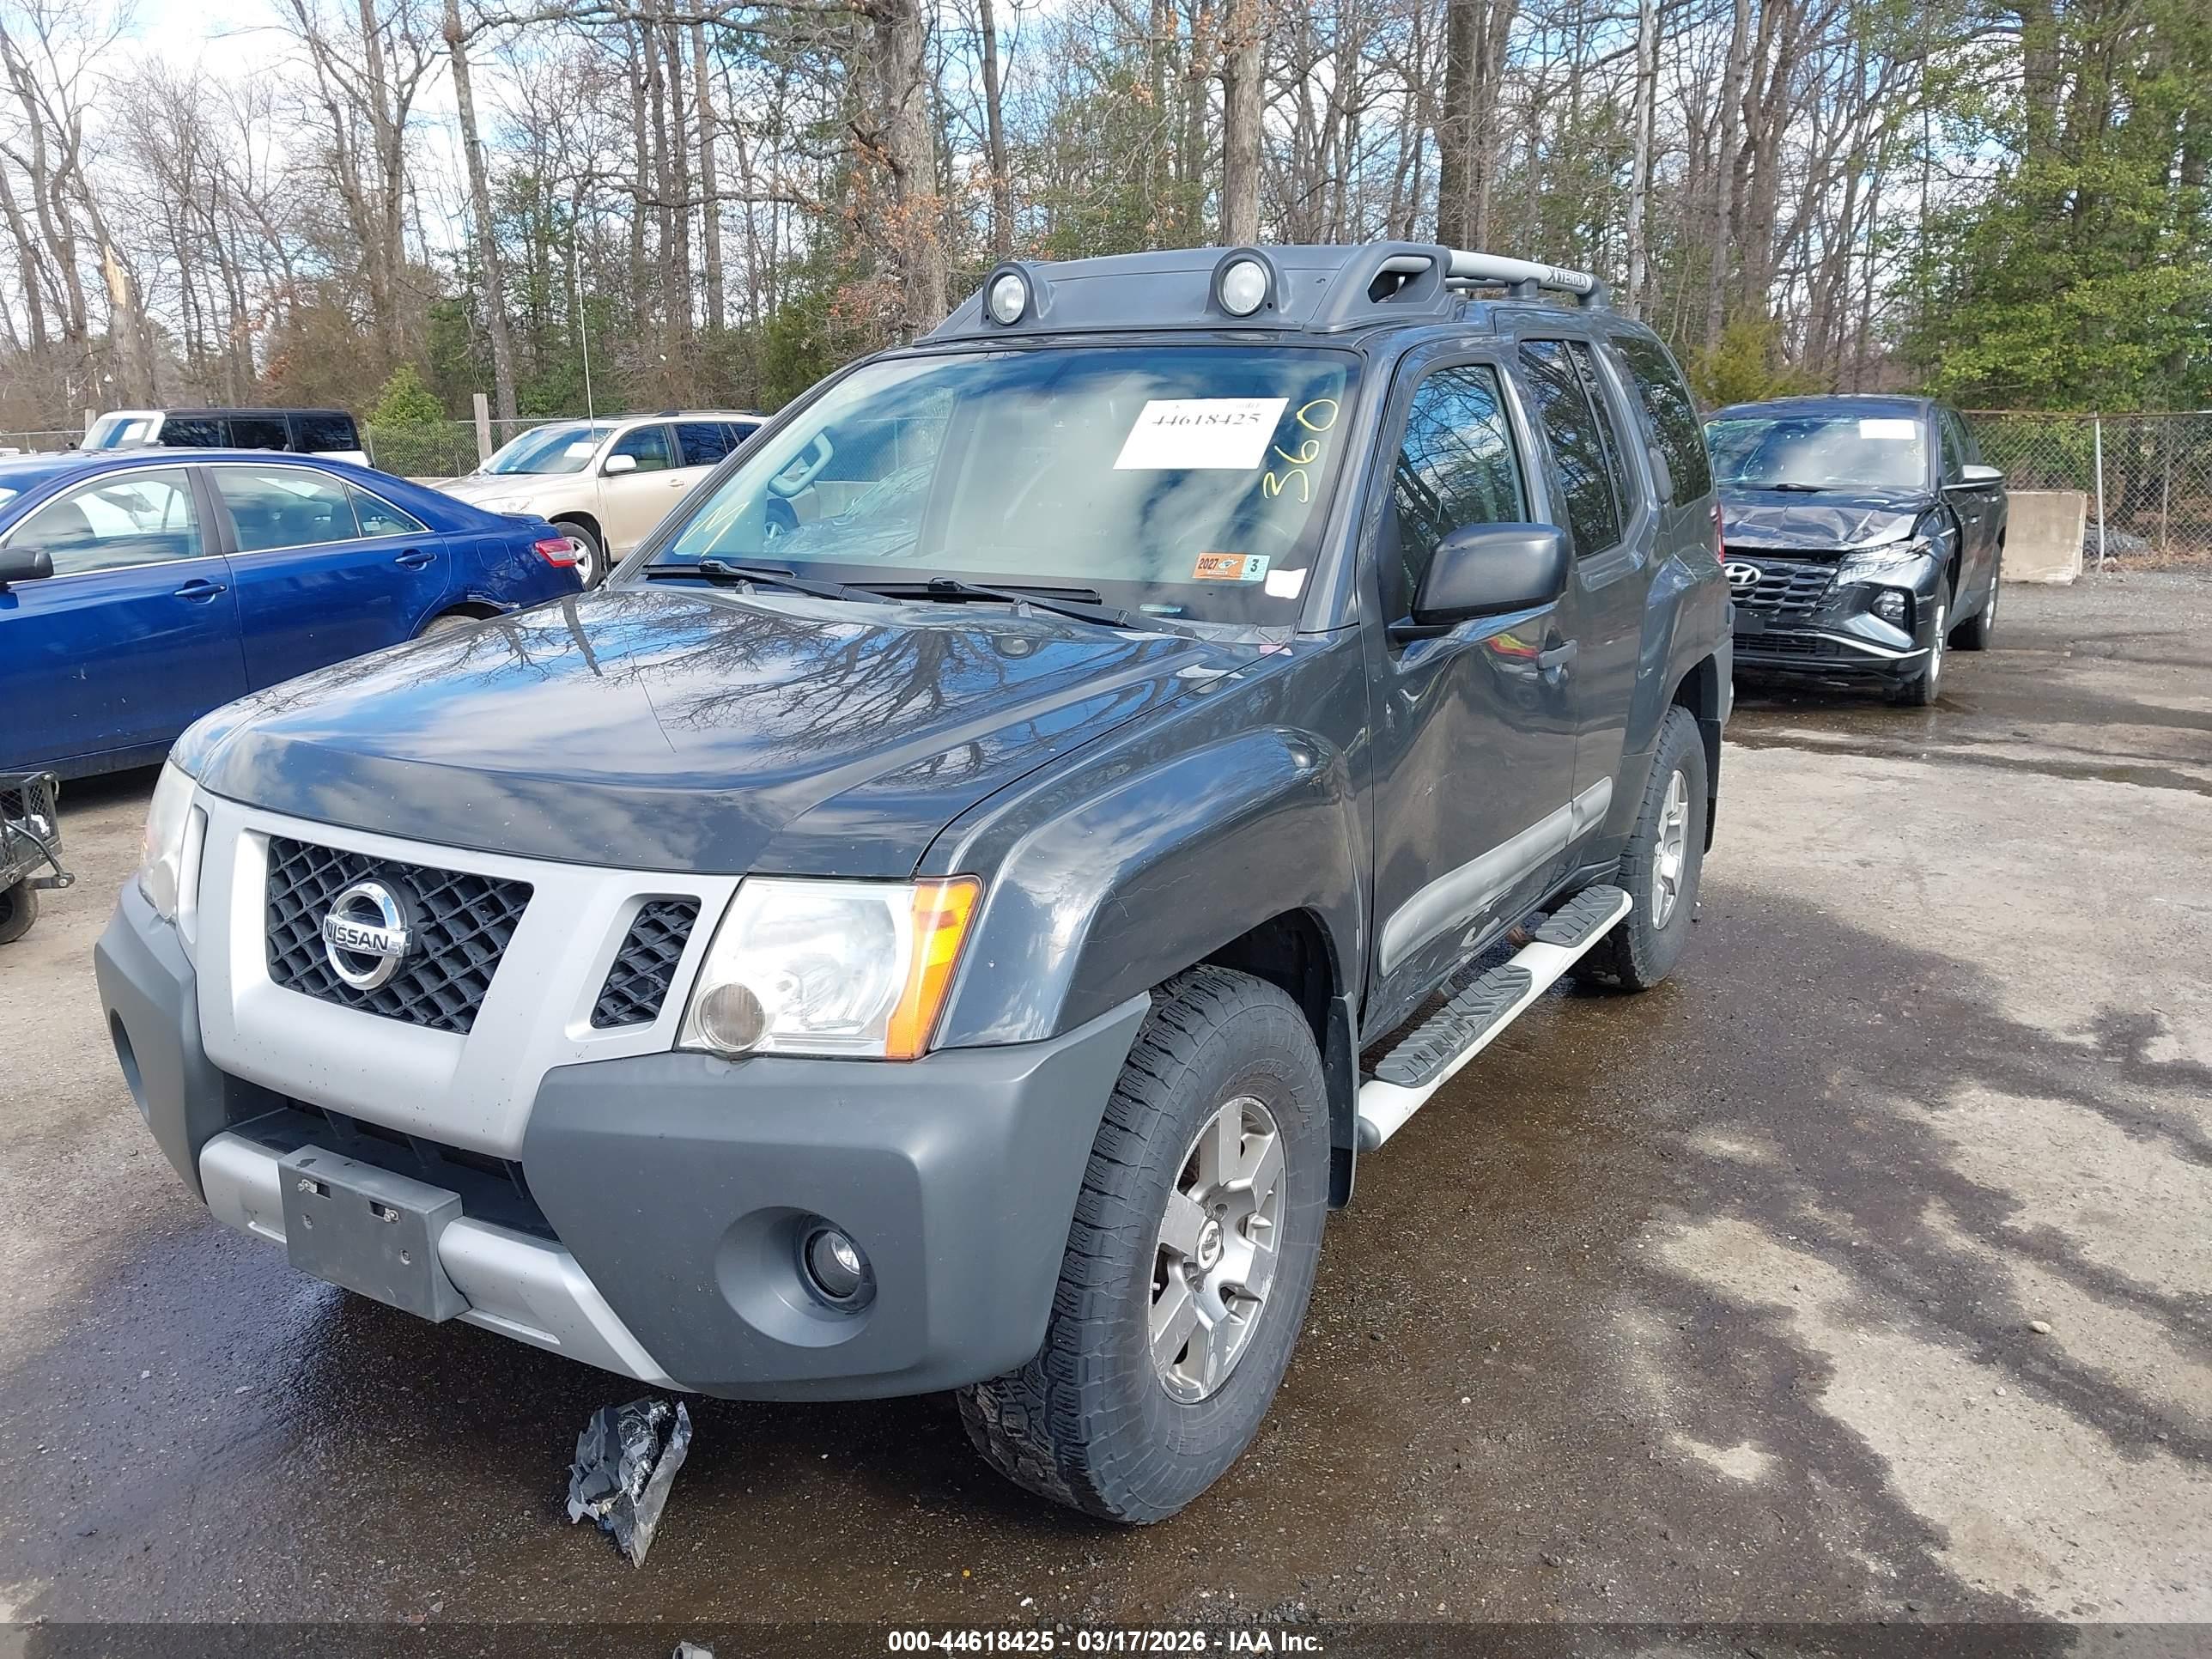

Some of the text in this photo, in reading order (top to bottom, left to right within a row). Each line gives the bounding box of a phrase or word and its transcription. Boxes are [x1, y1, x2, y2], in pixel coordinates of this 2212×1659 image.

[1546, 266, 1588, 289] XTERRA
[1152, 413, 1261, 426] 44618425
[1262, 398, 1339, 502] 360
[1197, 557, 1219, 570] 2027
[1249, 558, 1260, 573] 3
[323, 922, 389, 952] NISSAN
